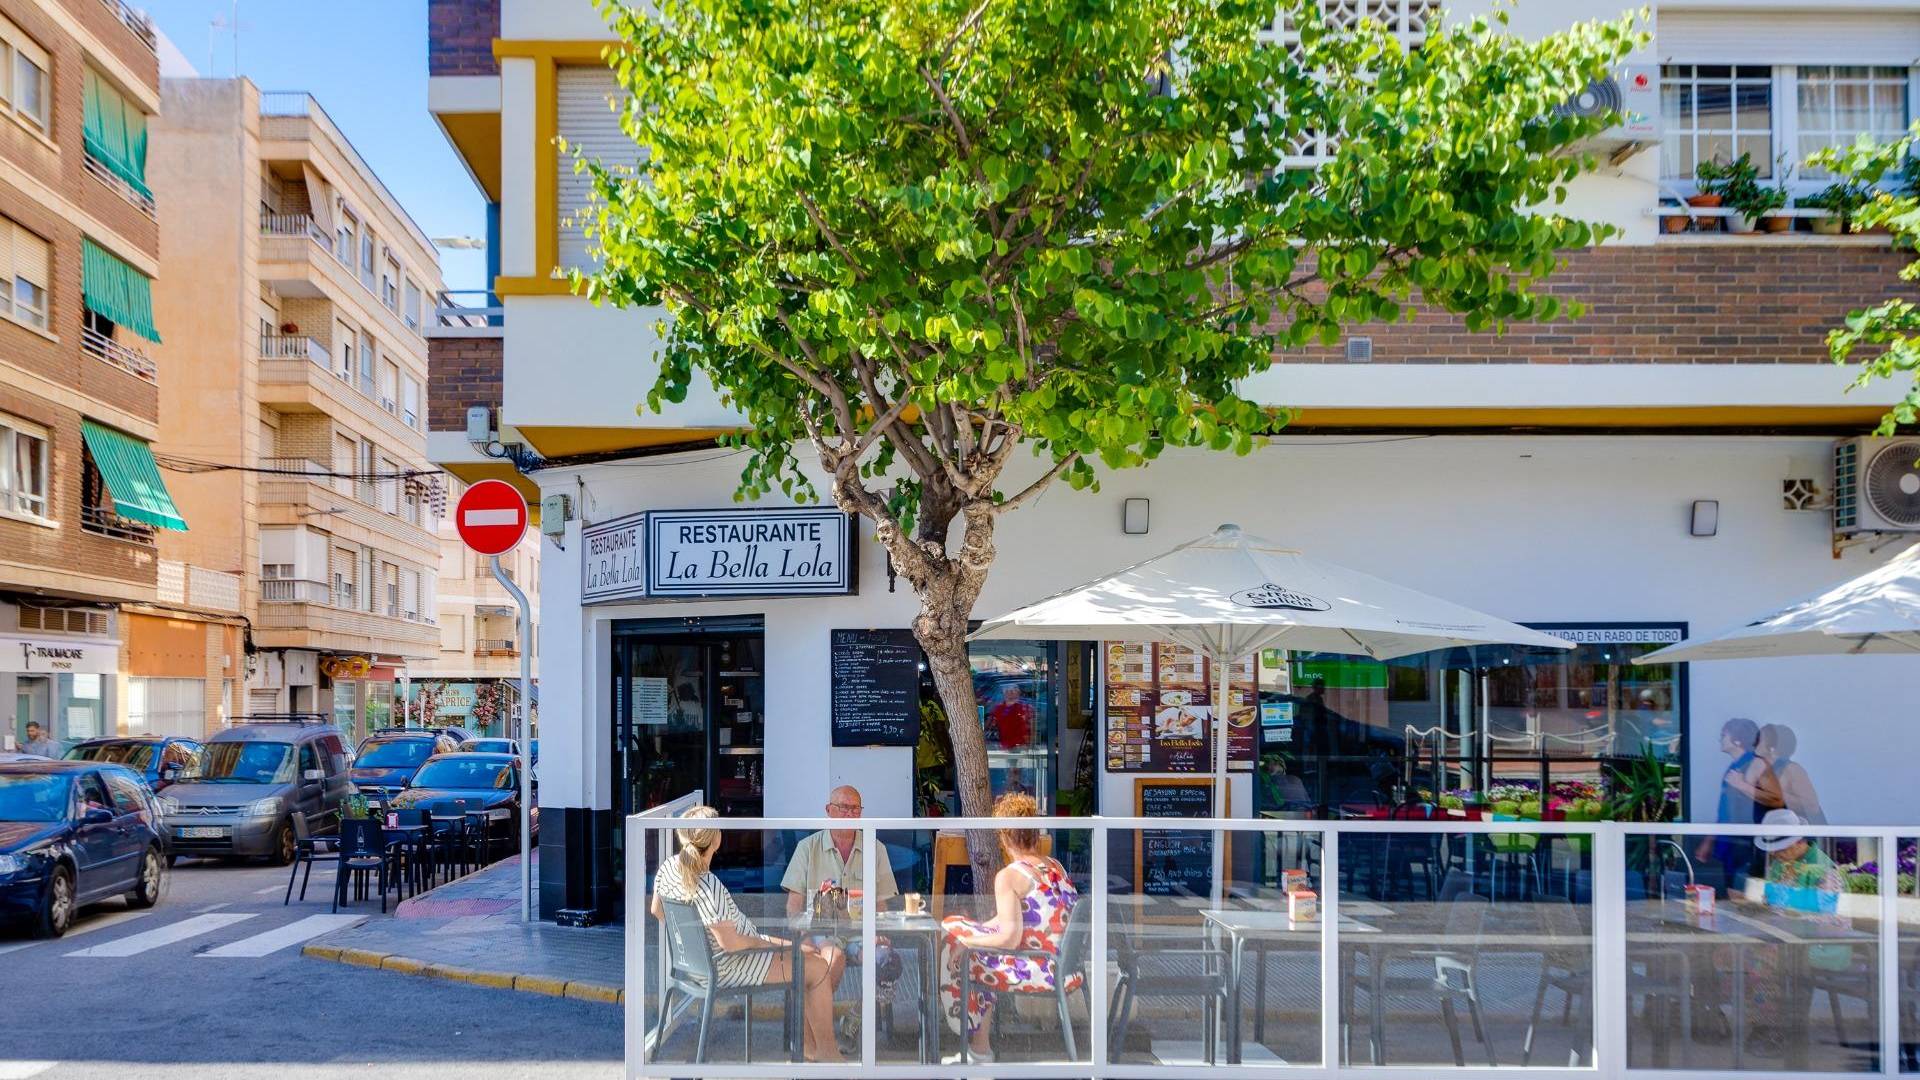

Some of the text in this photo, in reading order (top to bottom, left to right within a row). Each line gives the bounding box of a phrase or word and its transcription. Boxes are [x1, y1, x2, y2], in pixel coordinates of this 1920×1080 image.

[680, 522, 821, 544] RESTAURANTE
[591, 529, 636, 556] RESTAURANTE
[587, 549, 640, 589] La Bella Lola
[666, 543, 833, 581] La Bella Lola
[1246, 591, 1312, 602] Estrella
[1252, 597, 1314, 607] Galicia
[1587, 631, 1601, 641] EN
[1604, 631, 1634, 641] RABO
[1635, 631, 1649, 641] DE
[1651, 630, 1679, 641] TORO
[438, 696, 472, 707] APRICE
